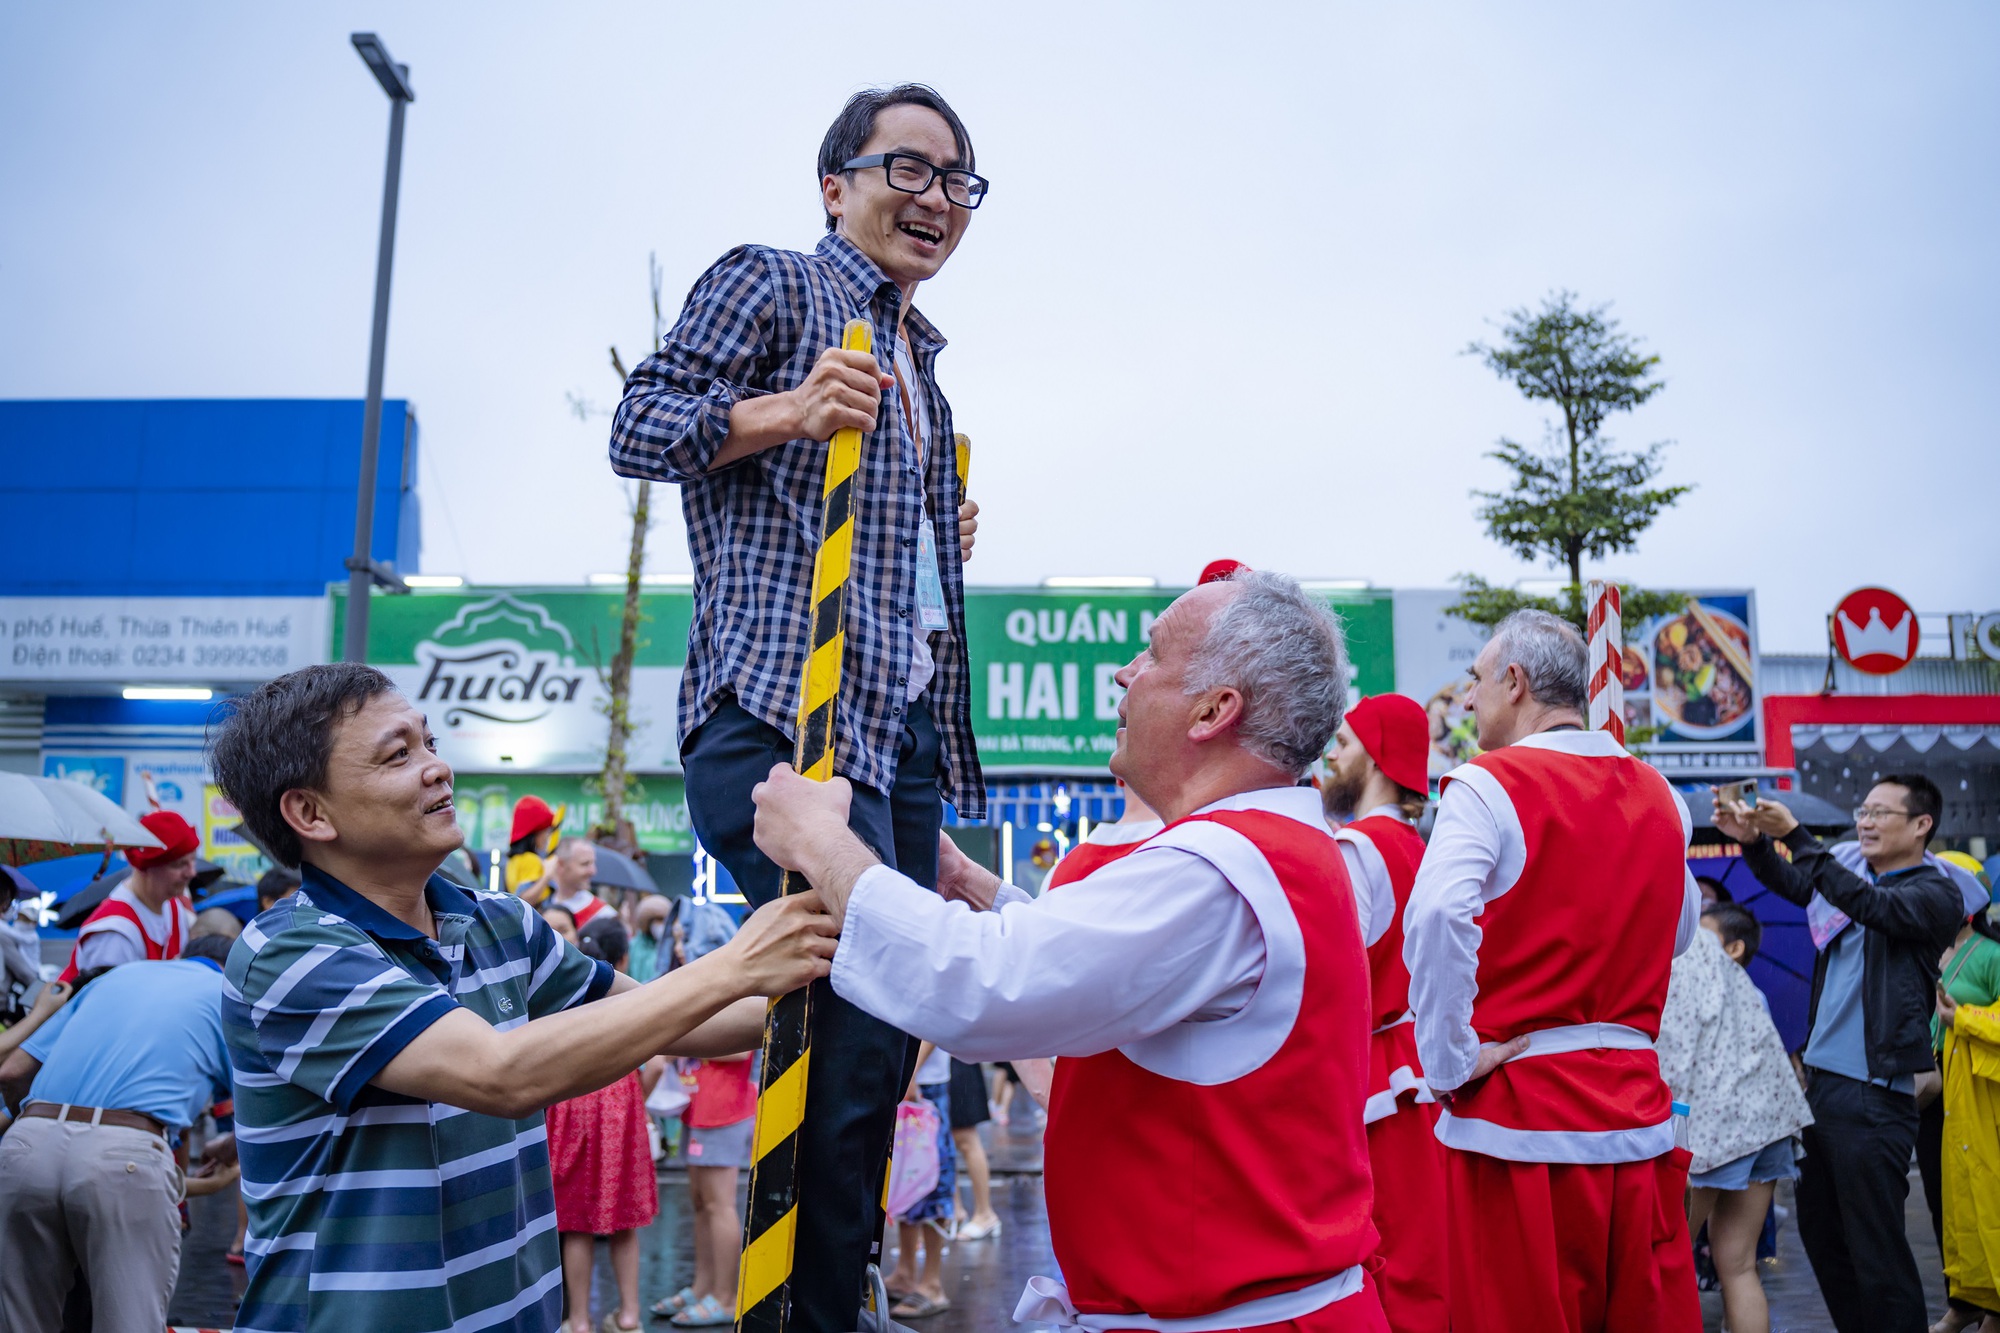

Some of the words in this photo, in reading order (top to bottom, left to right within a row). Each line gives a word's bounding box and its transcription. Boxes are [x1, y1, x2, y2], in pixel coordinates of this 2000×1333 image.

[13, 613, 54, 641] phố
[60, 613, 110, 640] Huế,
[180, 615, 239, 639] Thiên
[245, 612, 291, 639] Huế
[1006, 603, 1127, 645] QUÁN
[132, 644, 185, 667] 0234
[418, 650, 584, 703] huda
[987, 662, 1080, 720] HAI
